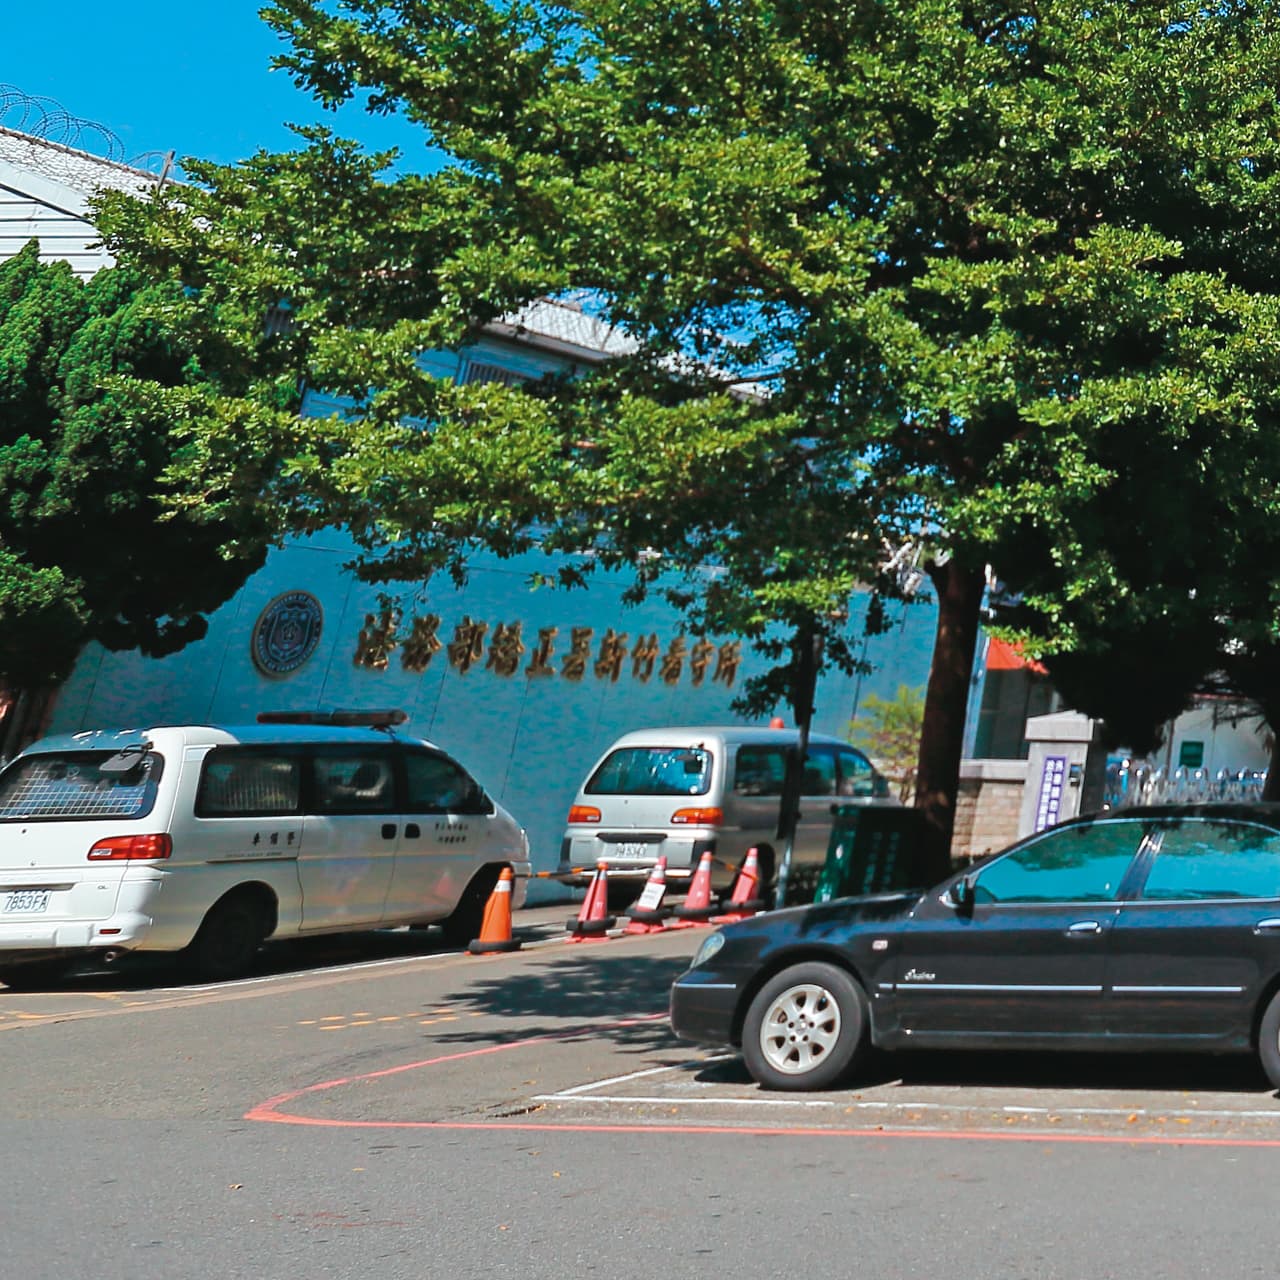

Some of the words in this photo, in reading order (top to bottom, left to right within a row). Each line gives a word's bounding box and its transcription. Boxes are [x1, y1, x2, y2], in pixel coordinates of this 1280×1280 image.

[353, 612, 742, 688] 法務部矯正署新竹看守所
